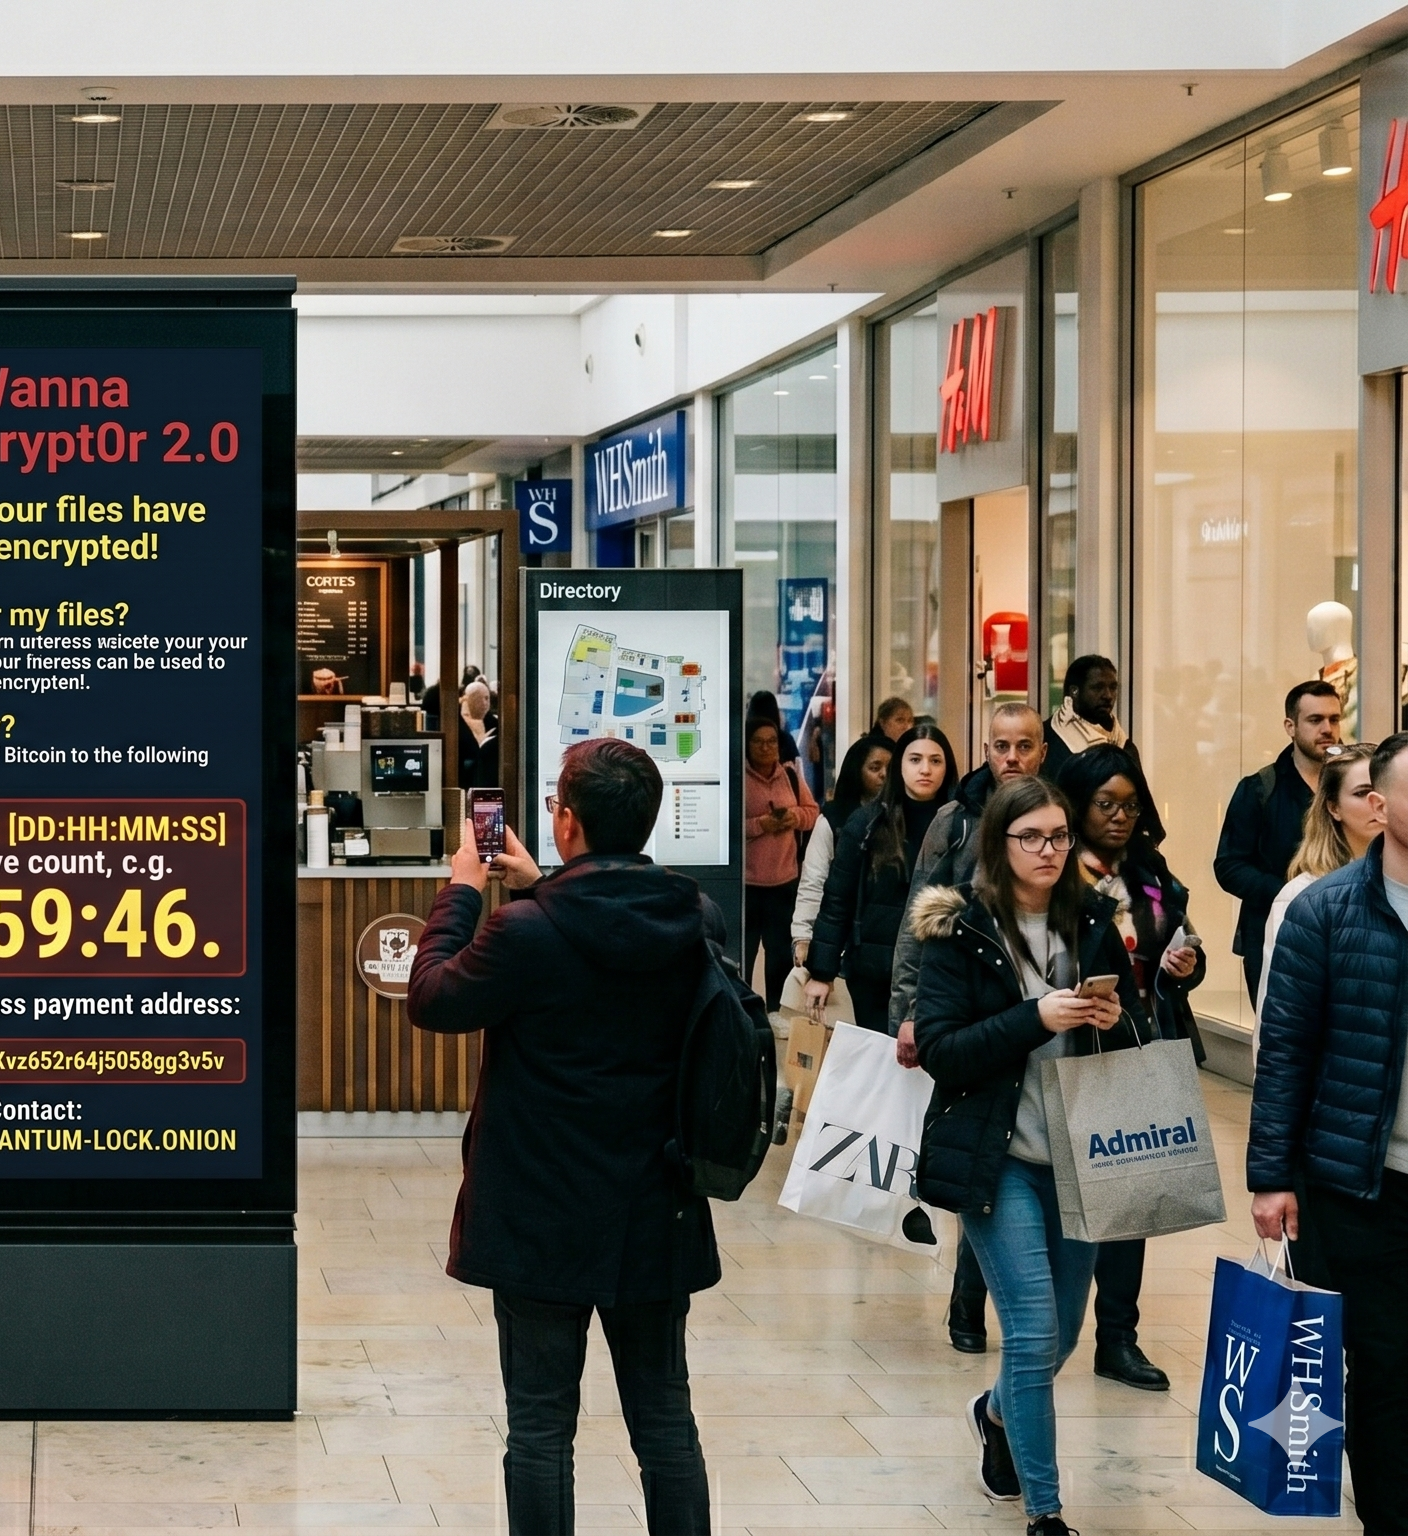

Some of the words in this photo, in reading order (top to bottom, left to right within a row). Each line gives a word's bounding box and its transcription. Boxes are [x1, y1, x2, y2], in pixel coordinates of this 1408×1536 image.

[162, 421, 239, 463] 2.0
[594, 427, 668, 516] WHSmith
[55, 494, 123, 523] files
[133, 494, 206, 523] have
[528, 487, 557, 502] WH
[528, 501, 559, 545] S
[539, 581, 621, 603] Directory
[10, 607, 50, 633] my
[56, 601, 130, 627] files?
[164, 636, 205, 654] your
[208, 636, 248, 654] your
[96, 656, 128, 670] can
[133, 653, 157, 670] be
[160, 653, 203, 670] used
[206, 654, 227, 670] to
[4, 745, 66, 764] Bitcoin
[70, 747, 89, 764] to
[93, 745, 123, 764] the
[126, 745, 209, 768] following
[9, 812, 226, 847] [DD:HH:MM:SS]
[28, 850, 113, 879] count,
[122, 854, 173, 881] c.g.
[33, 993, 134, 1021] payment
[140, 991, 240, 1015] address:
[1088, 1116, 1197, 1159] Admiral
[809, 1122, 920, 1199] ZAR
[1286, 1314, 1325, 1494] WHSmith
